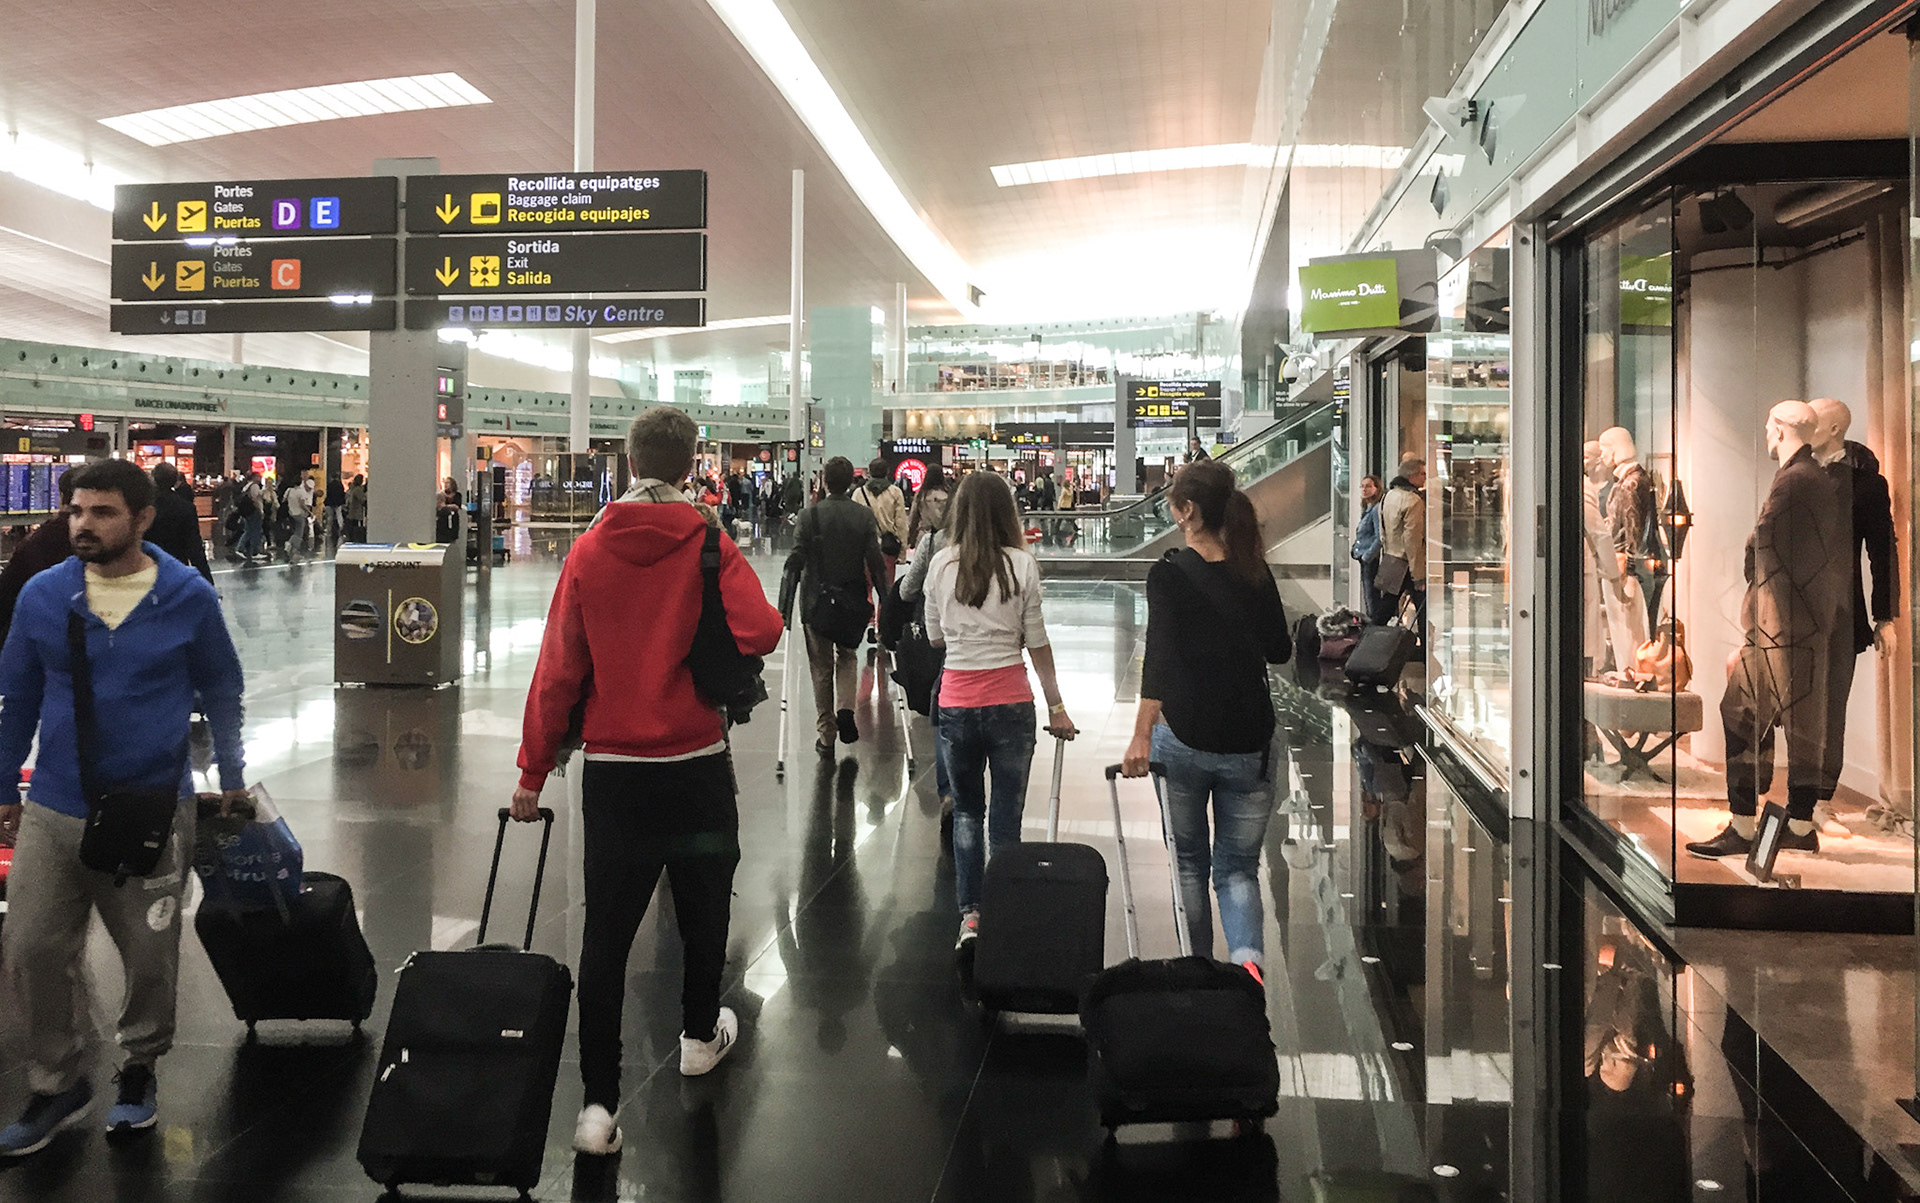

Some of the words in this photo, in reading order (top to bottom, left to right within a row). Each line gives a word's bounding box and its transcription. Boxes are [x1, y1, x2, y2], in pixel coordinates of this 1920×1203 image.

[508, 177, 575, 191] Recollida
[580, 175, 660, 192] equipatges
[214, 185, 254, 198] Portes
[507, 193, 559, 208] Baggage
[561, 193, 592, 205] claim
[213, 202, 244, 213] Gates
[278, 203, 296, 226] D
[316, 201, 332, 225] E
[507, 209, 575, 224] Recogida
[580, 207, 650, 222] equipajes
[213, 217, 261, 229] Puertas
[213, 245, 253, 257] Portes
[507, 240, 560, 254] Sortida
[213, 261, 243, 273] Gates
[507, 257, 529, 269] Exit
[277, 264, 294, 286] C
[507, 272, 552, 285] Salida
[213, 277, 260, 288] Puertas
[1311, 288, 1356, 300] Massimo
[1358, 283, 1386, 296] Dutti
[564, 306, 598, 325] Sky
[604, 305, 664, 322] Centre
